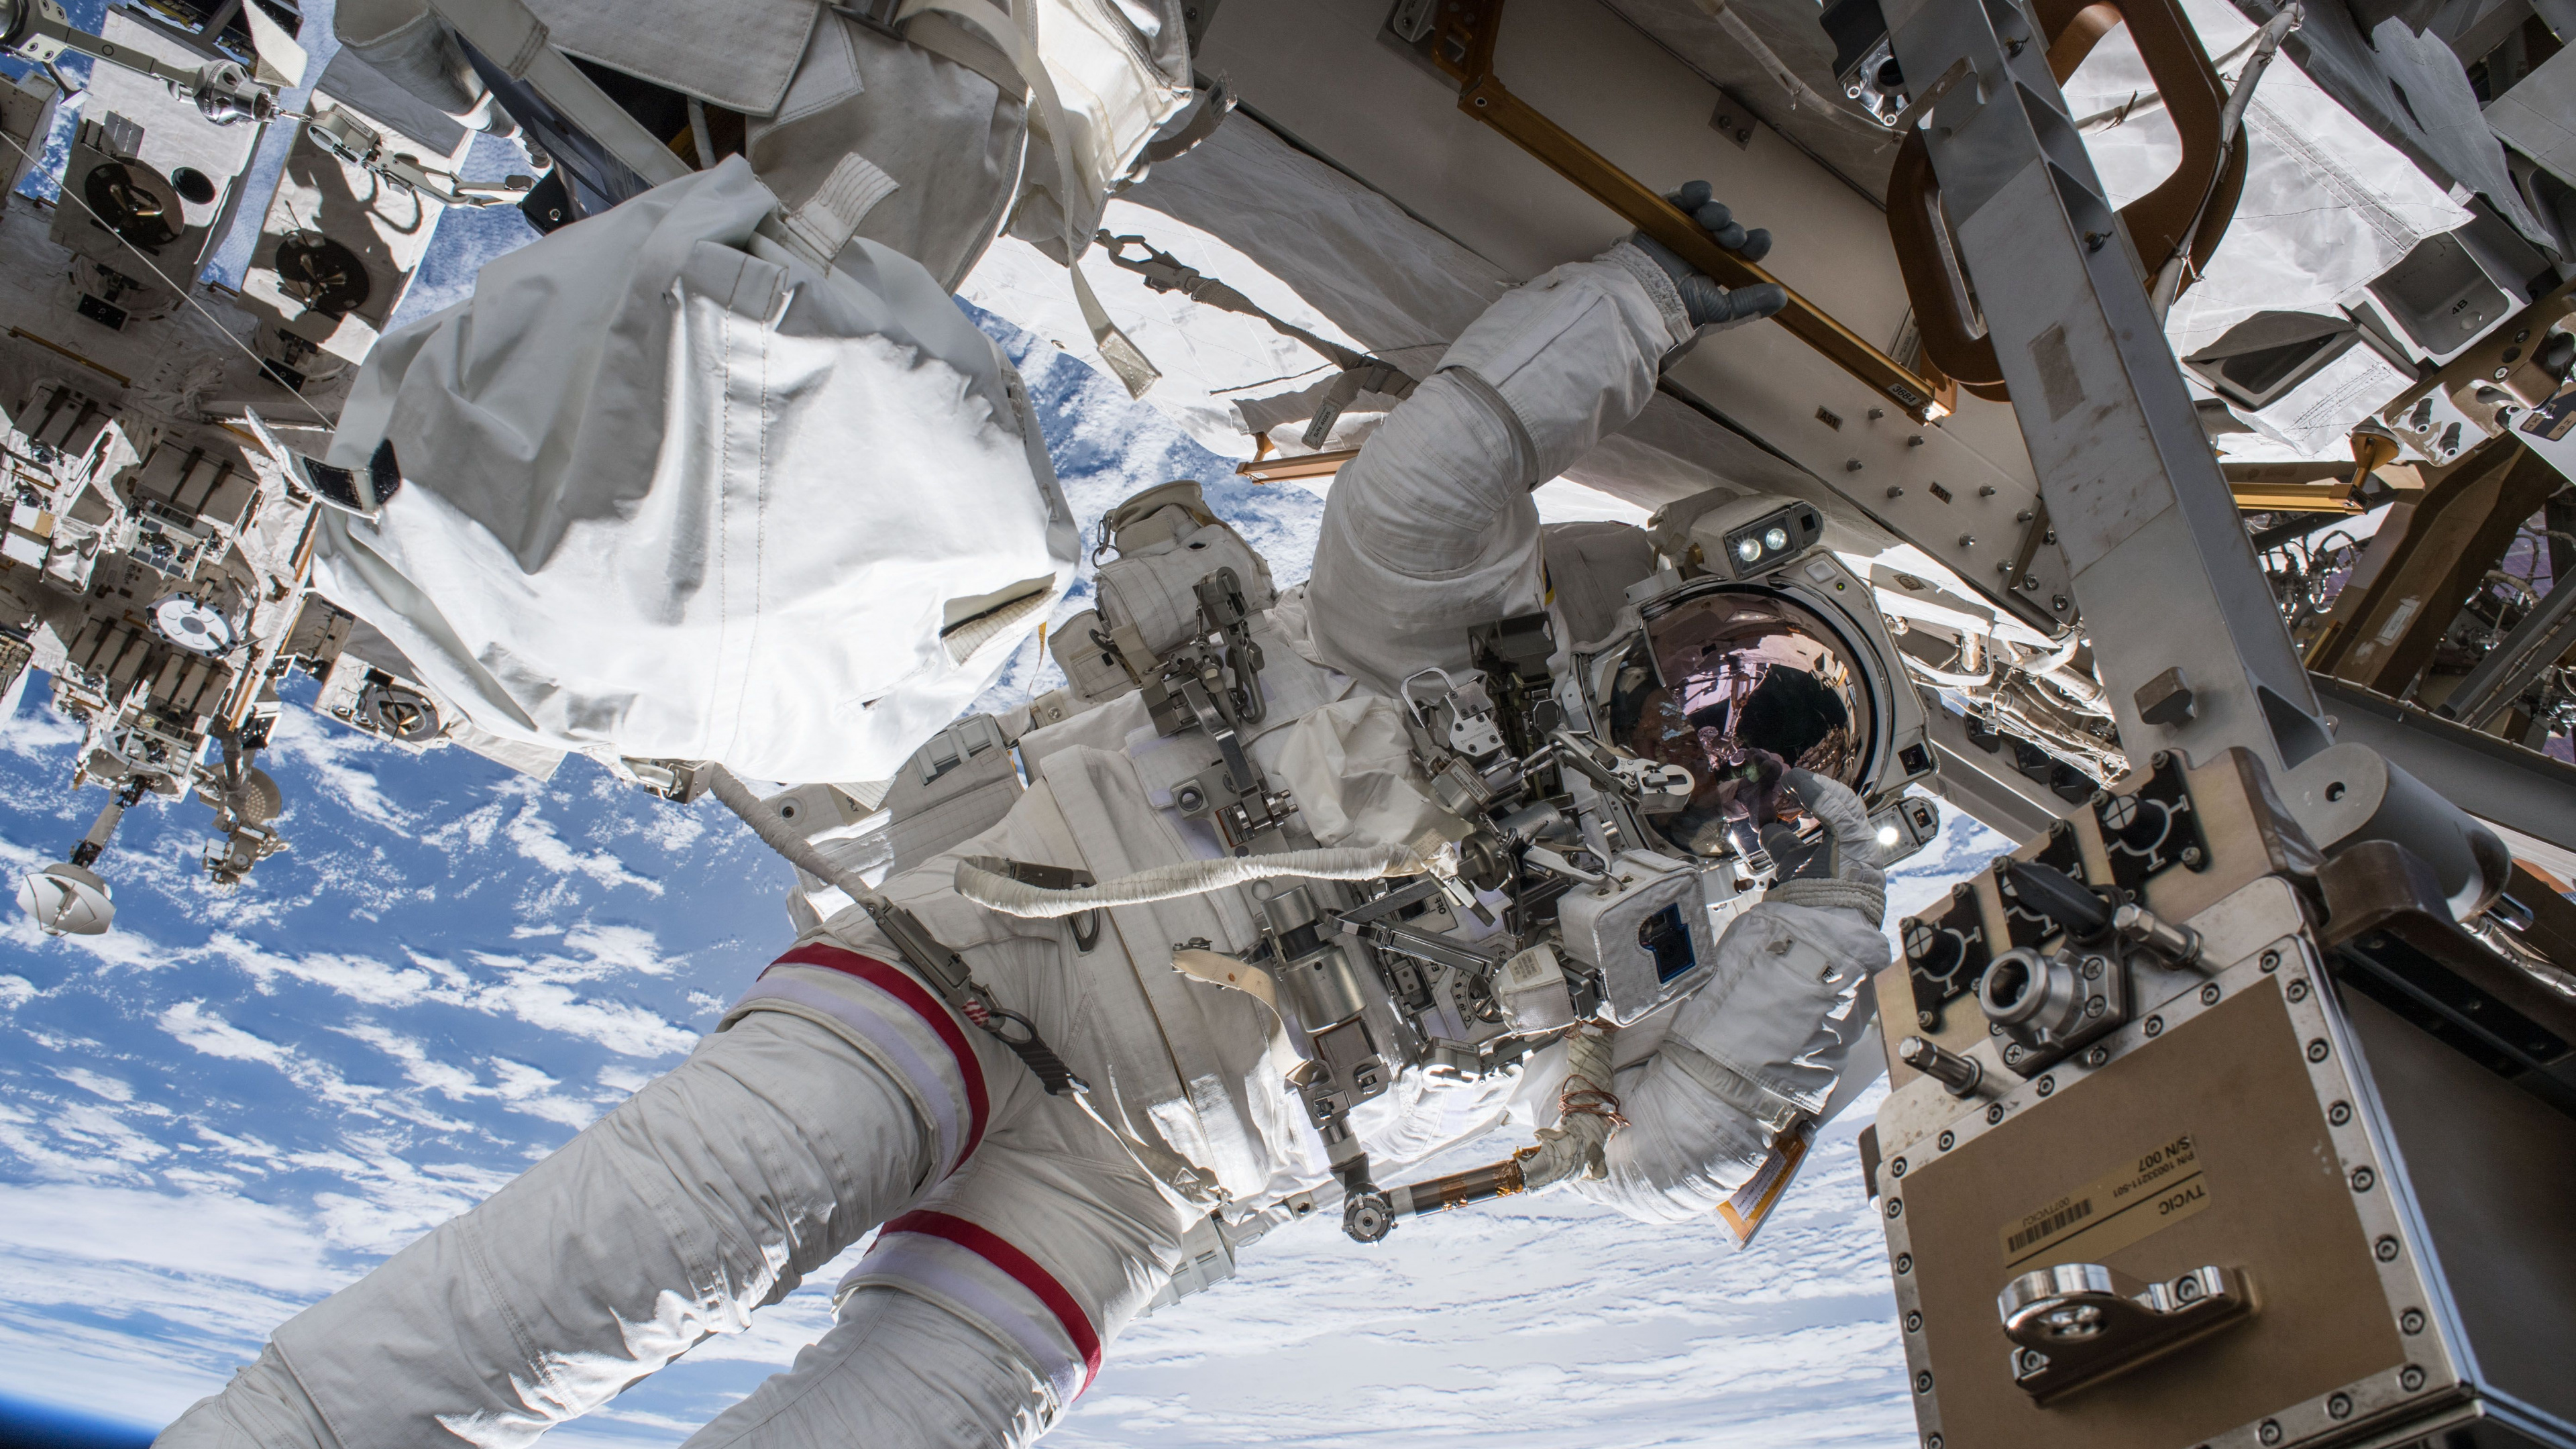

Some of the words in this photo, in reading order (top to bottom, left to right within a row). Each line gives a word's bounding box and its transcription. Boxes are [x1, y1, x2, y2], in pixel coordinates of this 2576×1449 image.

[2451, 299, 2469, 315] 4B
[1892, 385, 1917, 404] 3684
[1312, 425, 1322, 438] S/N
[1319, 410, 1331, 426] 4025
[1820, 411, 1838, 427] A51
[1932, 485, 1949, 500] A51
[2164, 1136, 2191, 1158] S/N
[2137, 1150, 2162, 1171] 007
[2177, 1151, 2194, 1165] P/N
[1365, 1197, 1386, 1210] TIGHTEN
[2157, 1185, 2206, 1216] TVCIC
